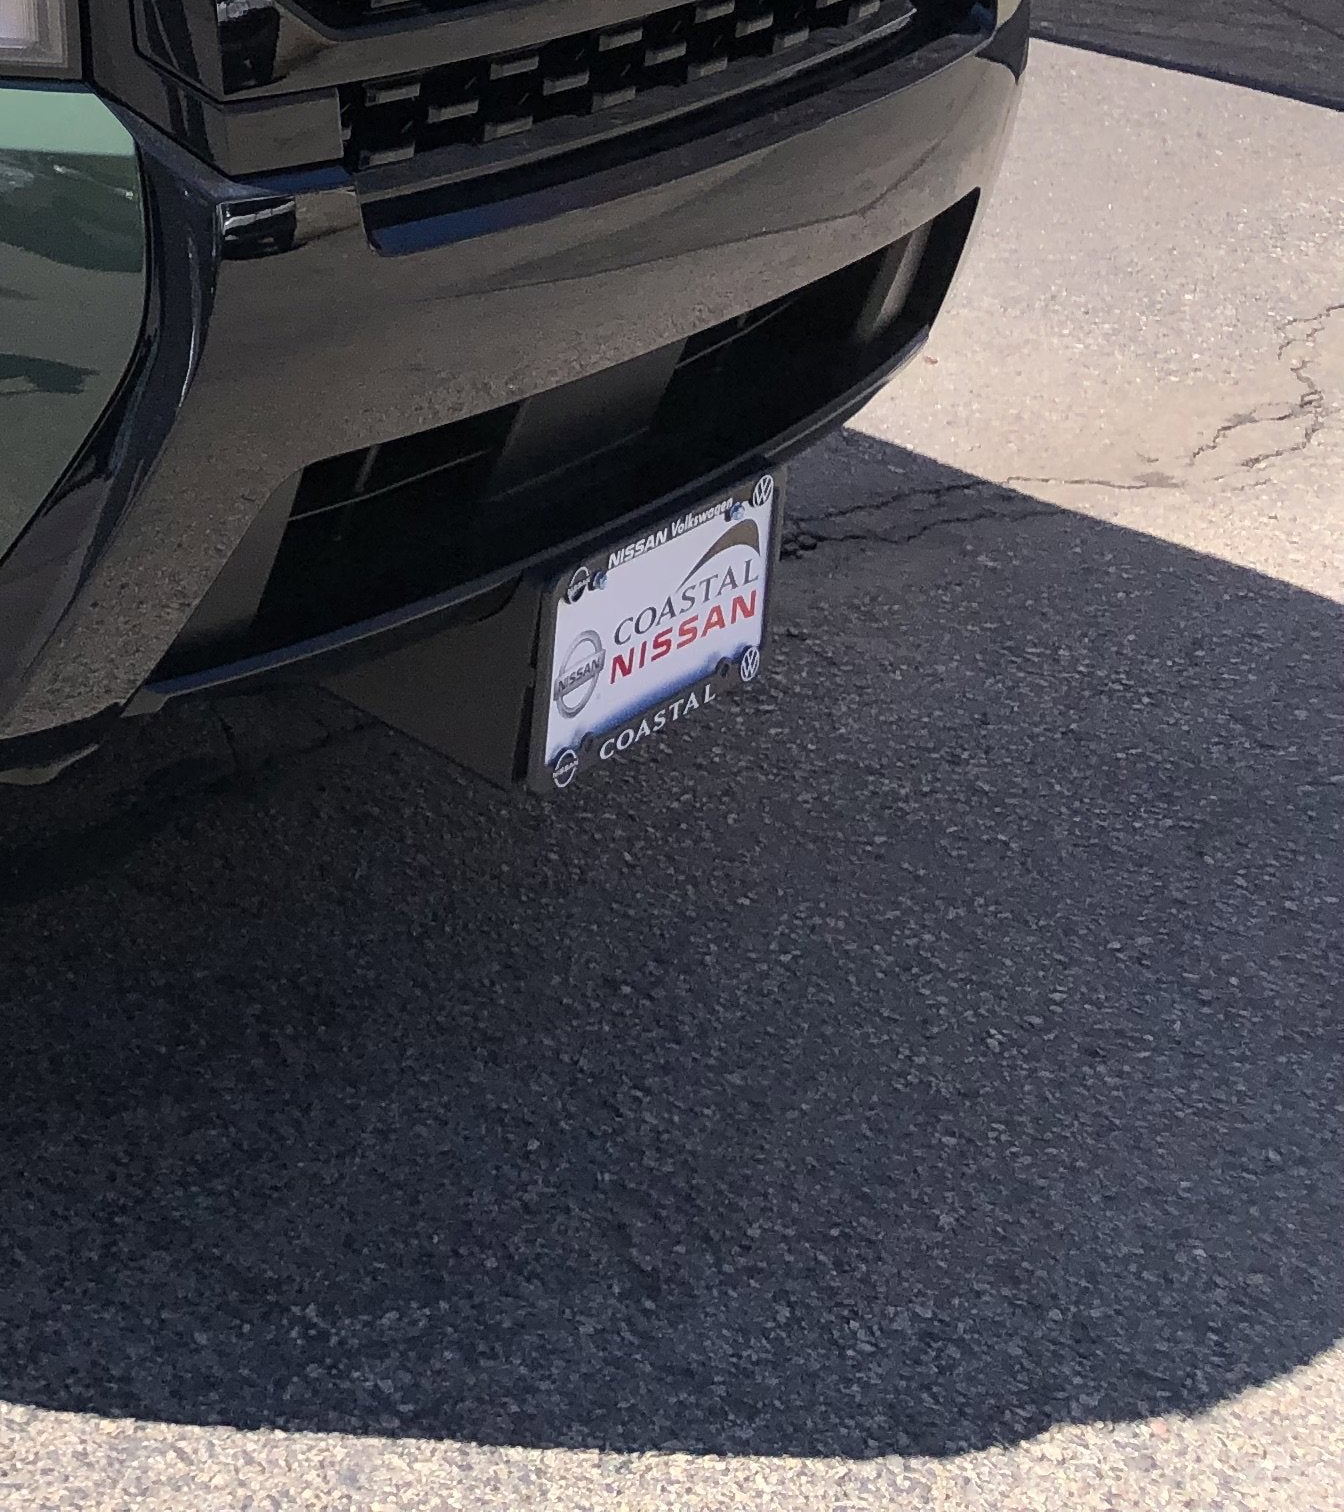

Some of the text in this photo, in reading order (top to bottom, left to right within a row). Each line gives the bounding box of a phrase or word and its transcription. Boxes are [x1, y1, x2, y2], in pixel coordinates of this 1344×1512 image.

[608, 497, 733, 569] NISSAN Volkswagen
[610, 590, 757, 684] NISSAN
[614, 558, 759, 645] COASTAL
[556, 656, 602, 690] NISSAN
[599, 683, 716, 760] COASTAL
